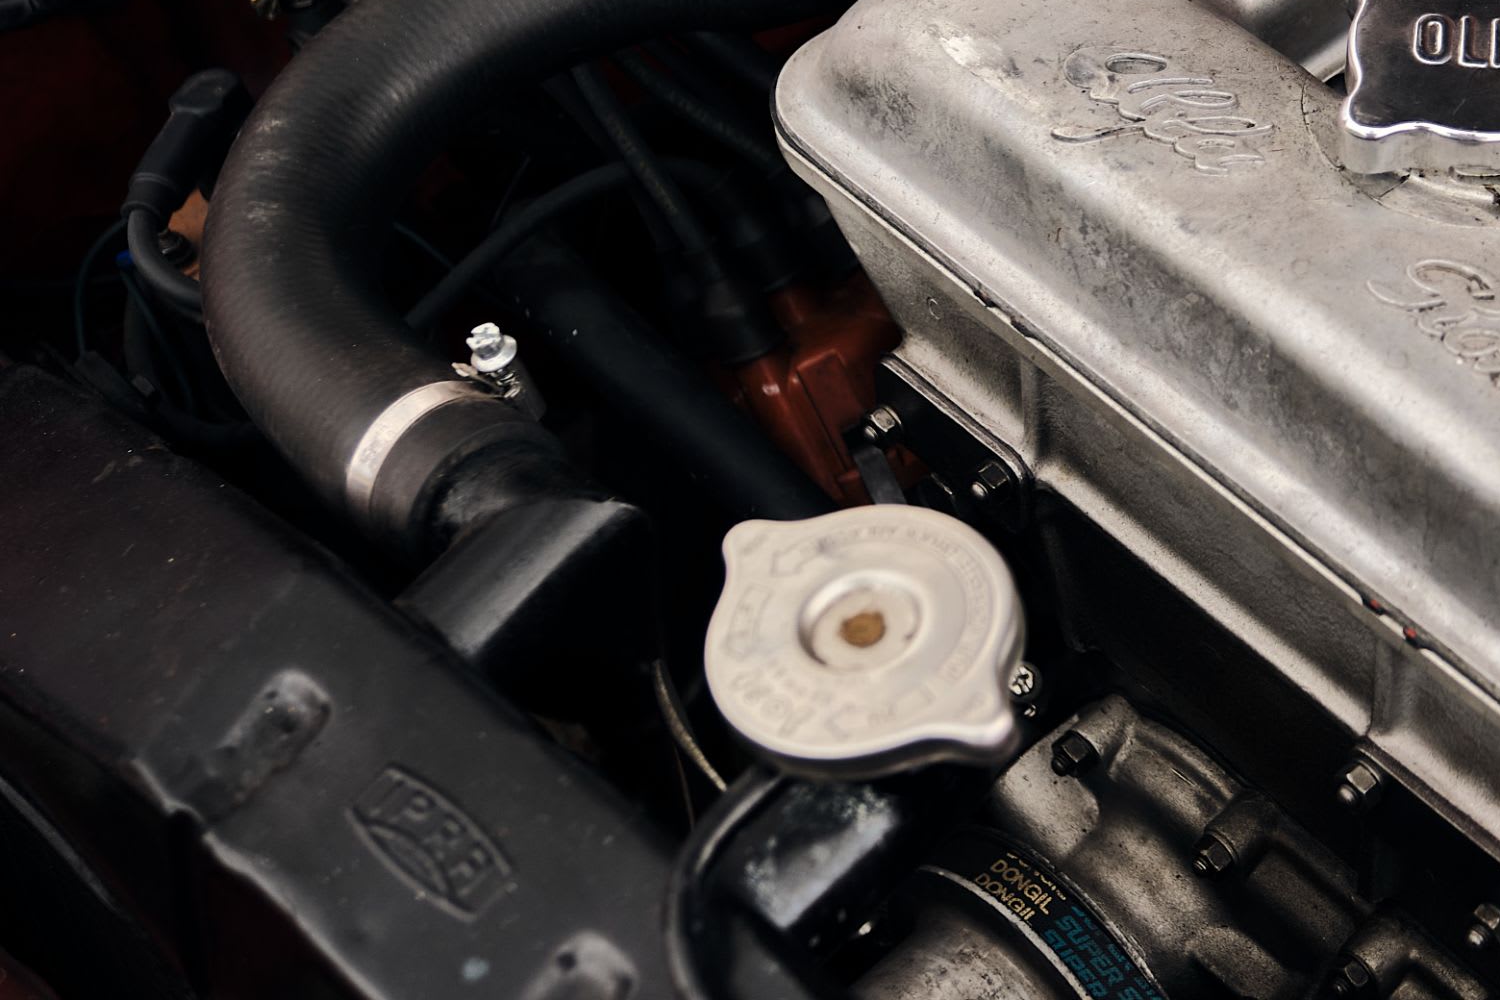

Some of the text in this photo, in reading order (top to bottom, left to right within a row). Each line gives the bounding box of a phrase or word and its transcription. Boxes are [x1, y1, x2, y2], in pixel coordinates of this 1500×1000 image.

[1050, 46, 1274, 178] Alfa
[989, 858, 1053, 916] DONGIL
[1054, 914, 1125, 987] SUPER
